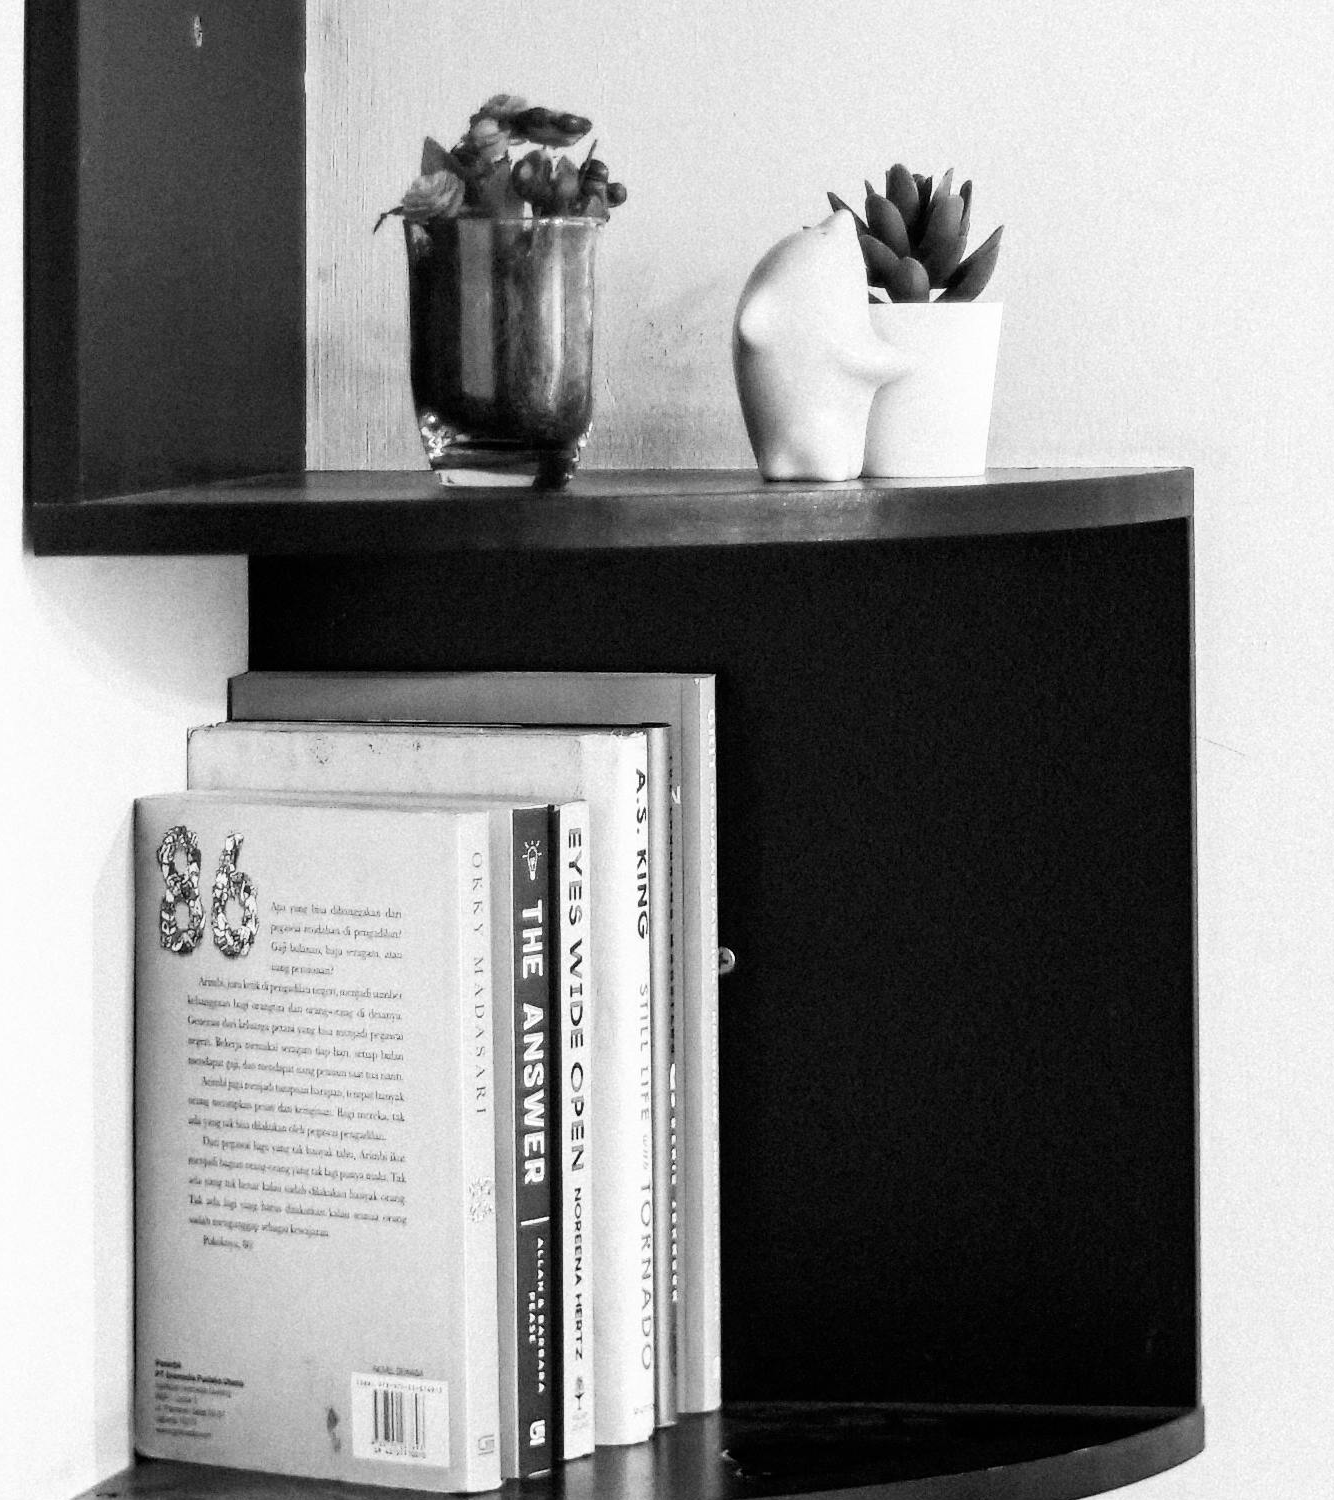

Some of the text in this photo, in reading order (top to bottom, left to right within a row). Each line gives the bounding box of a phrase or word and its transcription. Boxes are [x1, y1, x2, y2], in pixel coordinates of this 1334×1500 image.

[156, 825, 259, 960] 86
[636, 849, 649, 940] KING
[471, 852, 487, 1114] OKKY MADASARI
[522, 898, 545, 1185] THE ANSWER
[568, 827, 585, 1172] EYES WIDE OPEN
[640, 1066, 650, 1121] LIFE
[574, 1187, 583, 1361] NOREENA HERTZ
[640, 1184, 652, 1370] TORNADO
